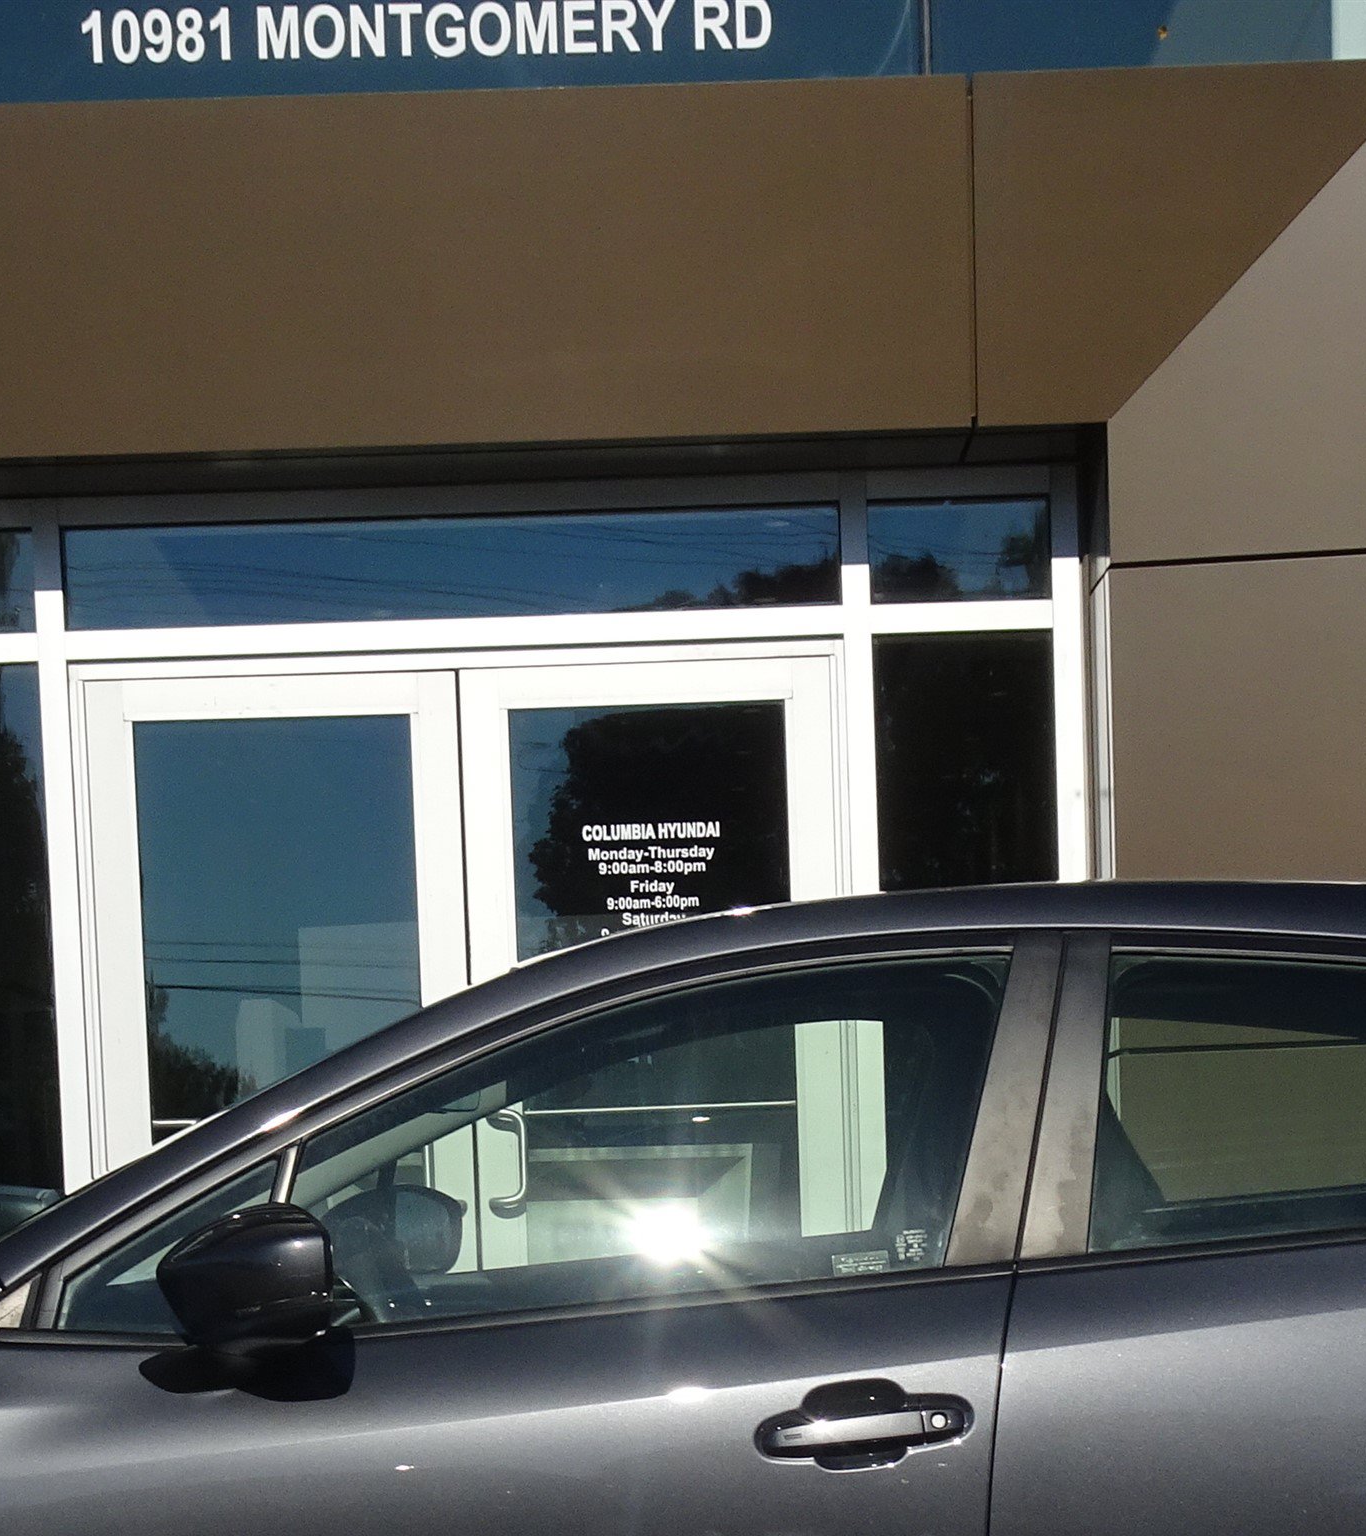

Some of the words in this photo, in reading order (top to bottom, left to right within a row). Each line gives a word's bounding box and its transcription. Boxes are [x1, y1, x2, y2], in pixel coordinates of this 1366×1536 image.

[81, 6, 232, 64] 10981
[257, 0, 674, 60] MONTGOMERY
[694, 0, 772, 51] RD
[581, 822, 656, 842] COLUMBIA
[657, 820, 721, 839] HYUNDAI
[587, 845, 715, 863] Monday-Thursday
[598, 860, 707, 876] 9:00am-8:00pm
[630, 880, 675, 895] Friday
[606, 894, 700, 911] 9:00am-6:00pm
